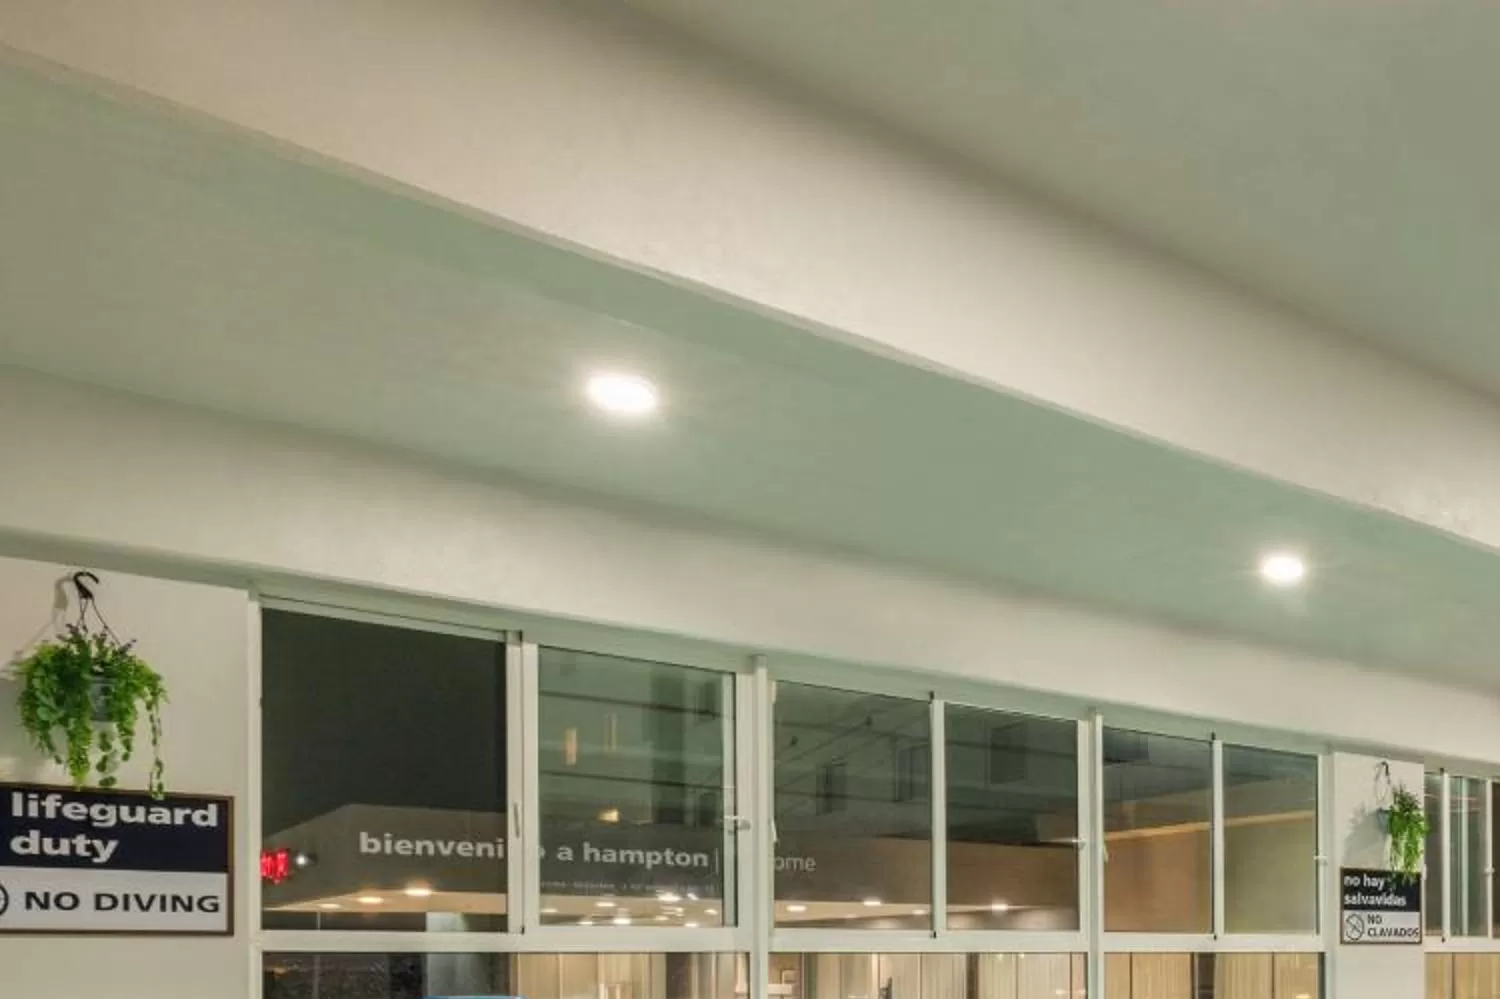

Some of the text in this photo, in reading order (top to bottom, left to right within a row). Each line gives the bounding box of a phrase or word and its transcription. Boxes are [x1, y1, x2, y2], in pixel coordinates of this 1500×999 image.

[11, 792, 219, 828] lifeguard
[9, 830, 119, 863] duty
[359, 831, 708, 869] bienveni a hampton
[1344, 873, 1385, 891] no hay
[25, 891, 220, 913] NO DIVING
[1343, 892, 1407, 907] salvavidas
[1367, 913, 1383, 925] NO
[1367, 927, 1420, 937] CLAVADOS
